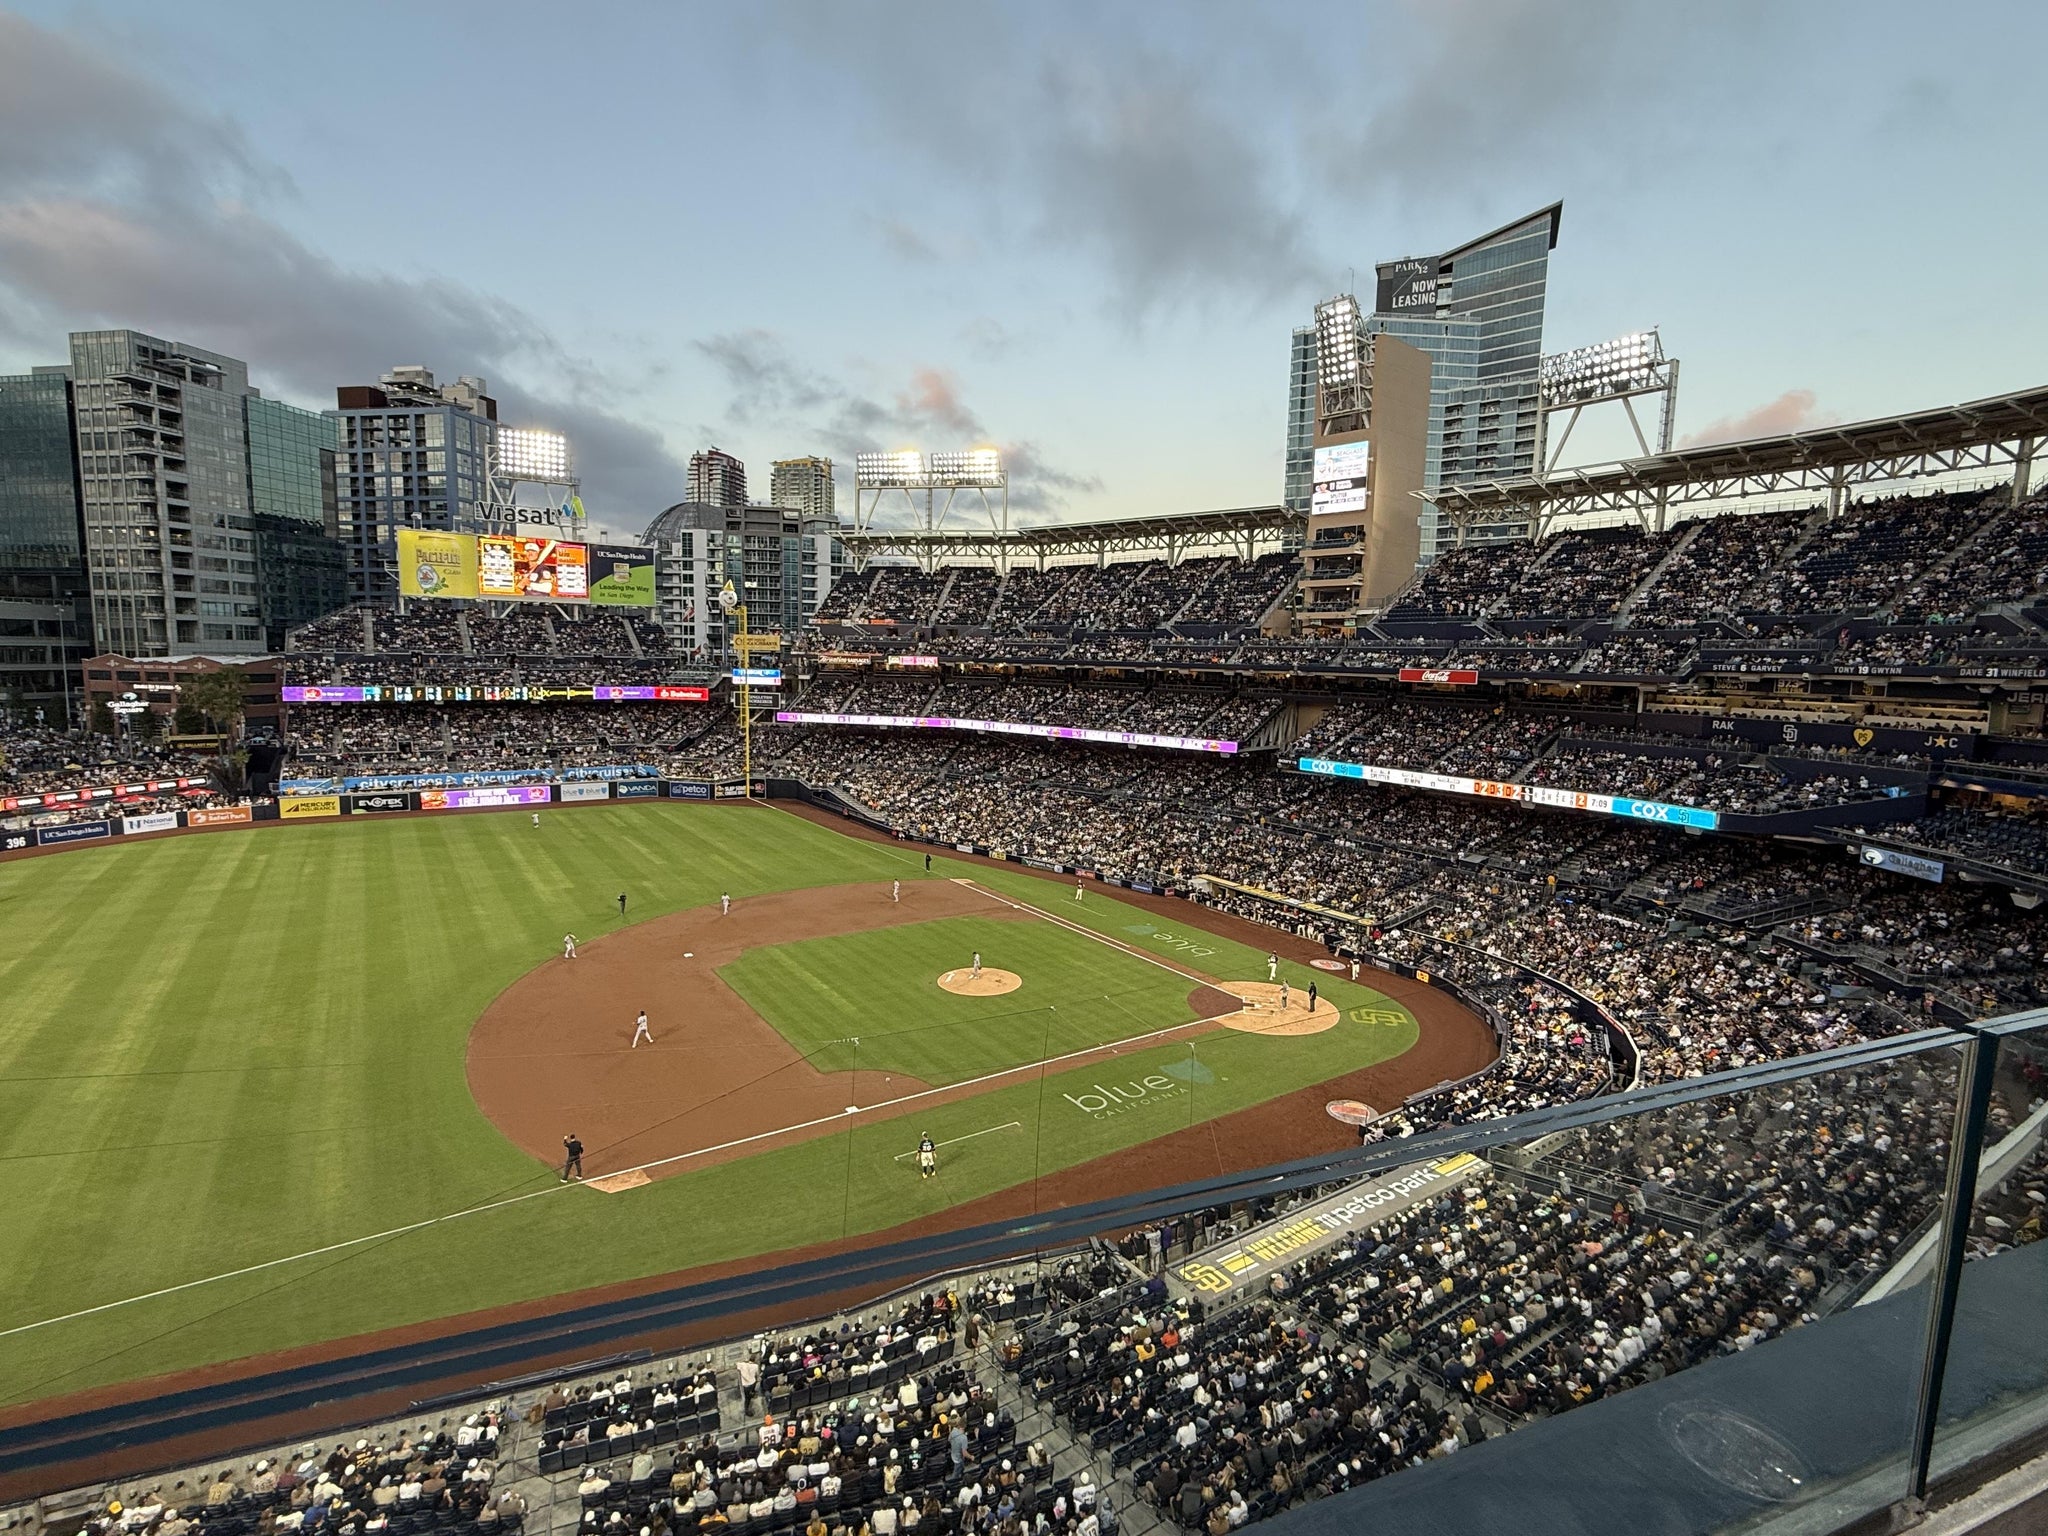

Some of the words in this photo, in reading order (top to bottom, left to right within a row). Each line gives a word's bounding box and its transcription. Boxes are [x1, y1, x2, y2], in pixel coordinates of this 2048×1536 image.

[1395, 262, 1419, 272] PARK
[1412, 279, 1436, 293] NOW
[1392, 292, 1436, 308] LEASING
[478, 501, 554, 525] Viasat
[600, 584, 624, 592] Leading
[1858, 666, 1869, 674] 19
[1986, 668, 1998, 677] 31
[2001, 669, 2046, 677] WINFIELD
[1422, 671, 1451, 681] Coca-Cola
[106, 701, 149, 709] Gallagher
[1712, 721, 1735, 730] RAK
[1858, 732, 1868, 741] PS
[1311, 761, 1335, 773] COX
[627, 784, 657, 792] VANDA
[683, 784, 707, 794] petco
[359, 797, 402, 807] EVOTEK
[1578, 795, 1585, 805] 2
[1591, 799, 1608, 808] 7:09
[208, 812, 230, 821] Safari
[230, 811, 246, 820] Park
[1631, 802, 1668, 820] COX
[143, 816, 173, 825] National
[45, 830, 55, 839] UC
[54, 829, 67, 838] San
[67, 828, 85, 837] Diego
[85, 825, 104, 834] Health
[6, 837, 26, 849] 396
[1889, 854, 1939, 874] Gallagher
[1063, 1075, 1175, 1112] blue
[1094, 1088, 1188, 1120] CALIFORNIA
[1246, 1218, 1331, 1261] WELCOME
[1316, 1211, 1342, 1228] TO
[1332, 1187, 1395, 1224] petco
[1389, 1167, 1440, 1197] park
